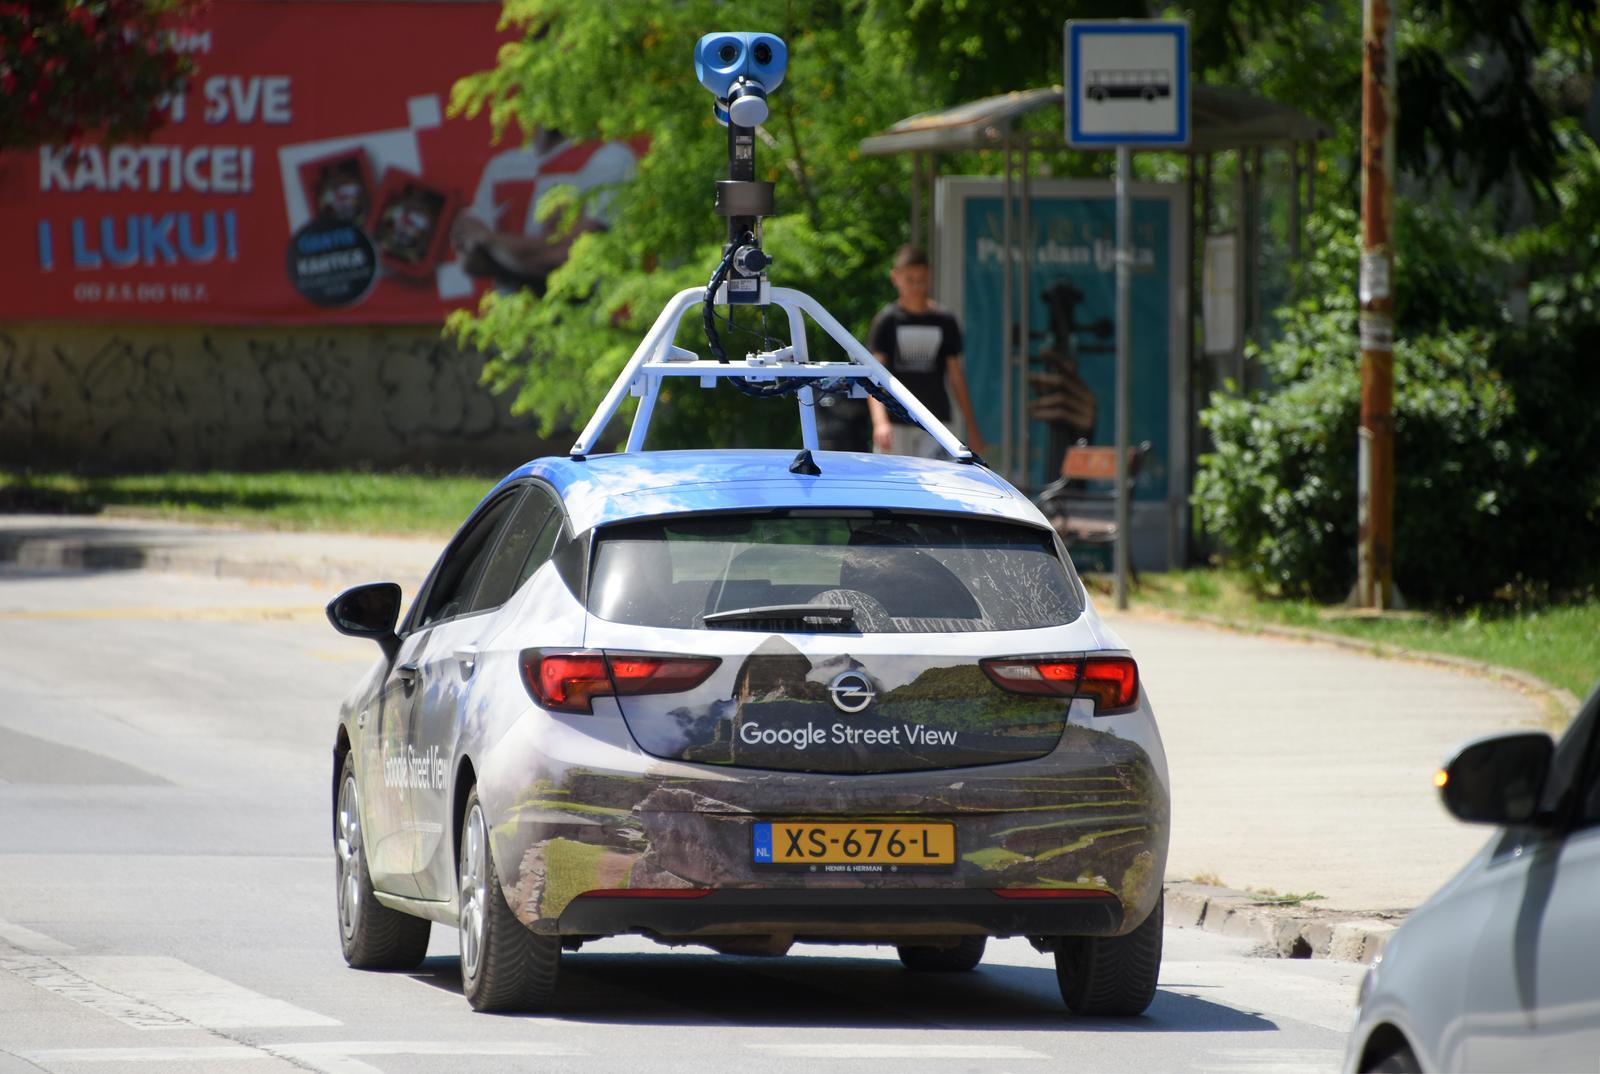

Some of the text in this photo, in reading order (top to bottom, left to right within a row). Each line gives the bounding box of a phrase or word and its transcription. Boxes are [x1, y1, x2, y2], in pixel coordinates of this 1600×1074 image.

[204, 76, 291, 123] SVE
[39, 146, 254, 192] KARTICE!
[37, 211, 237, 270] I LUKU!
[1038, 239, 1089, 264] dan
[740, 722, 958, 750] Google Street View
[383, 740, 448, 802] Google Street View
[756, 848, 770, 857] NL
[785, 828, 940, 858] XS-676-L
